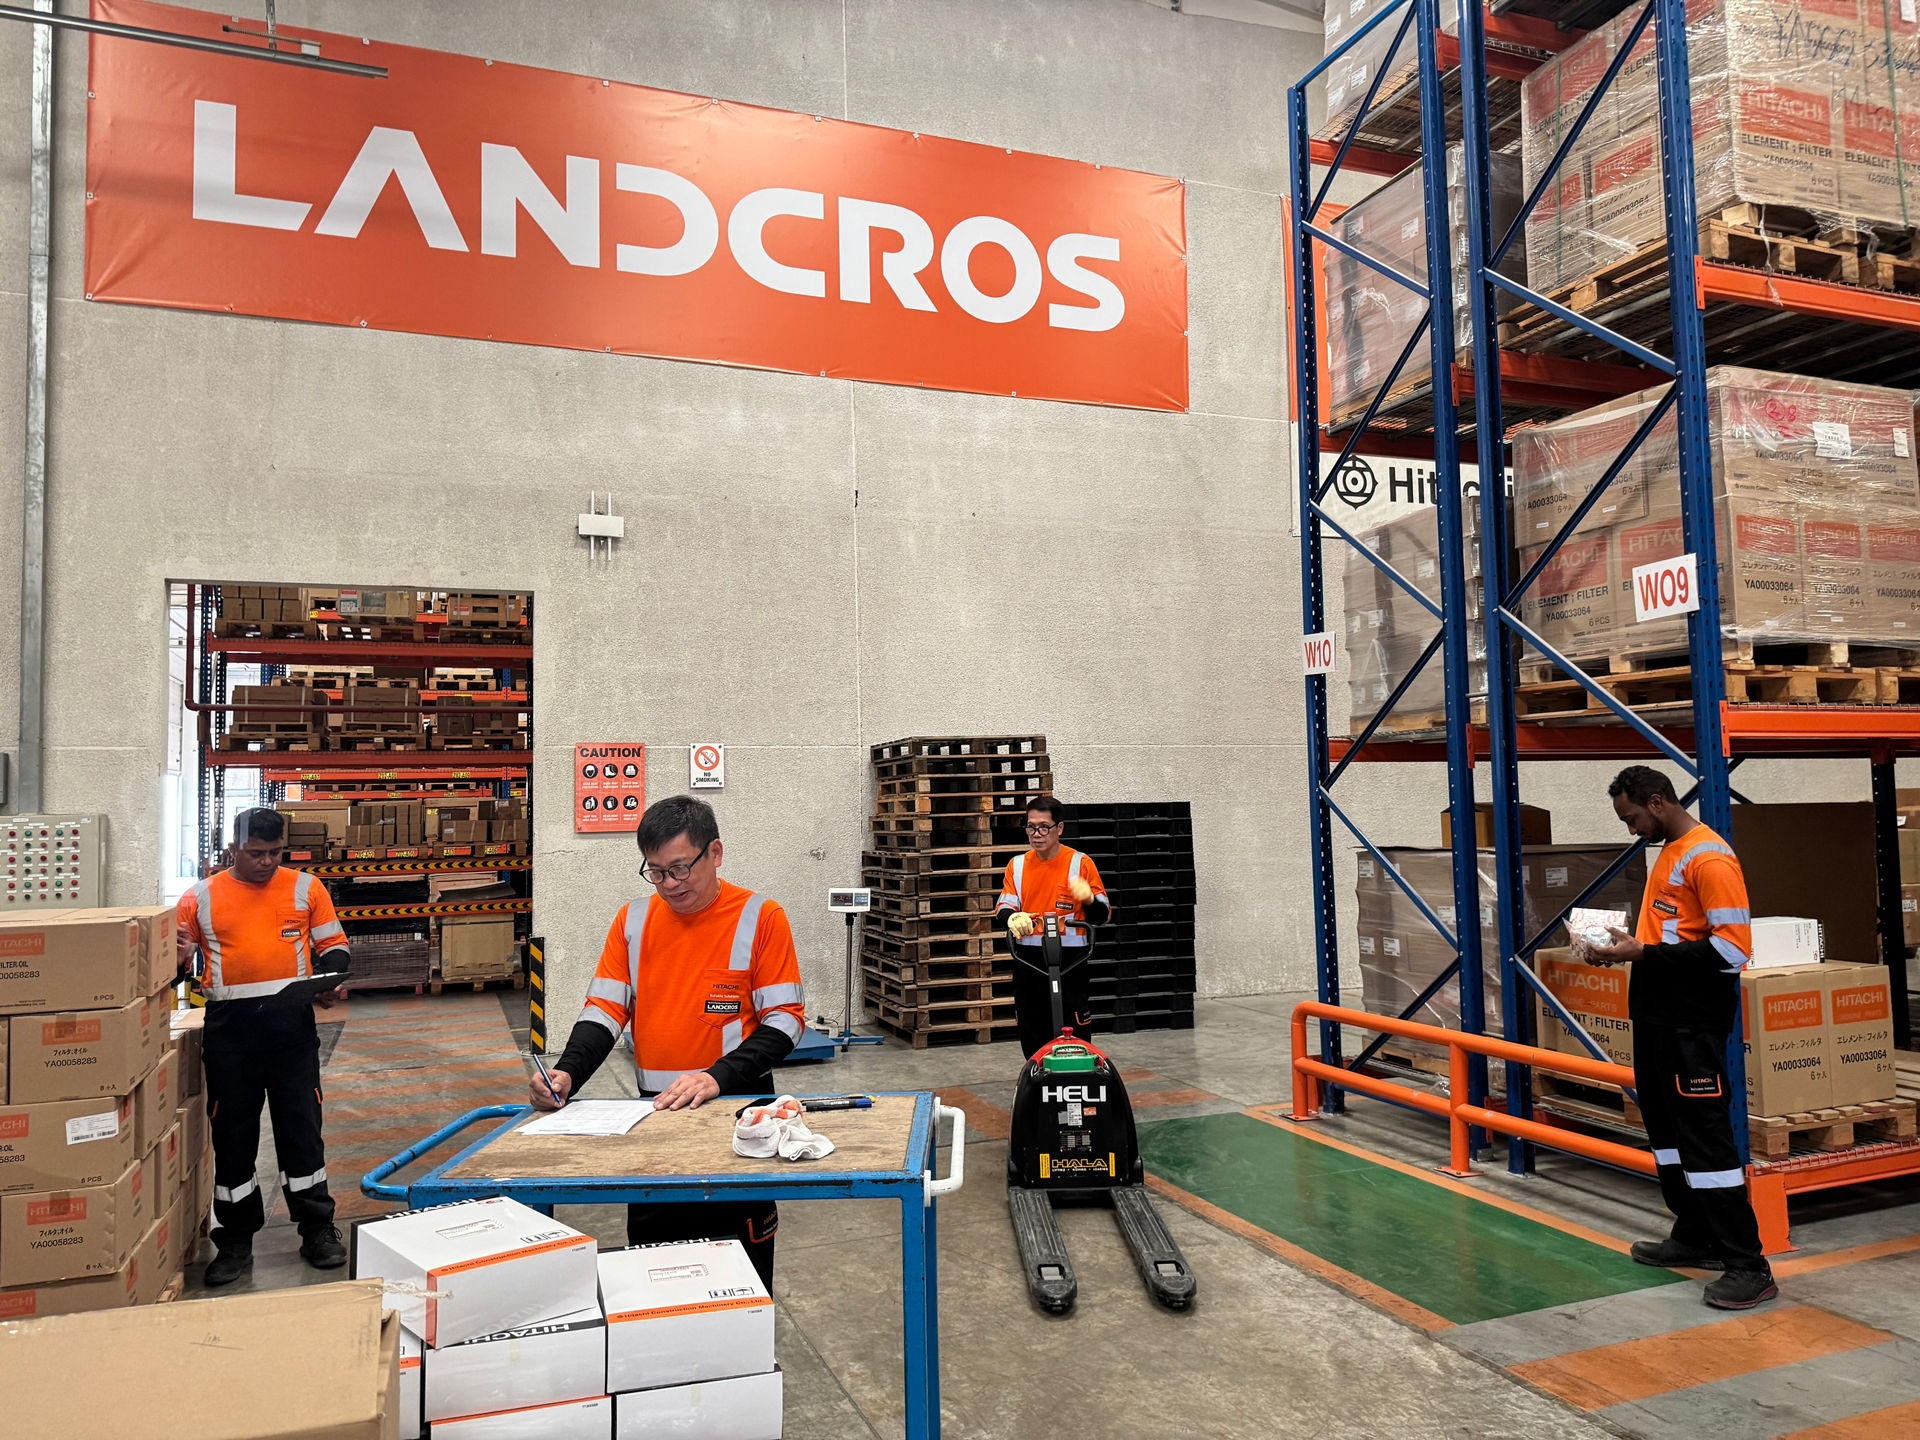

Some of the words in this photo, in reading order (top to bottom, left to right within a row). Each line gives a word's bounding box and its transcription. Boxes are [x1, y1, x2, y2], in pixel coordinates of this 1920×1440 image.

[1747, 92, 1823, 121] HITACHI
[1741, 133, 1790, 151] ELEMENT
[1798, 145, 1833, 159] FILTER
[192, 99, 1126, 334] LANDCROS
[1628, 527, 1684, 553] HITAC
[1576, 585, 1609, 600] FILTER
[1744, 578, 1794, 592] YA00033064
[1546, 606, 1591, 623] YA00033064
[1594, 615, 1610, 626] PCS
[580, 747, 642, 758] CAUTION
[18, 960, 29, 968] OIL
[0, 970, 40, 980] 00058283
[1546, 969, 1620, 994] HITACHI
[1767, 997, 1817, 1014] HITACHI
[1836, 991, 1883, 1008] HITACHI
[1595, 1016, 1630, 1032] FILTER
[44, 1057, 97, 1068] YA00058283
[1614, 1050, 1631, 1061] PCS
[1840, 1049, 1887, 1065] YA00033064
[1771, 1056, 1822, 1073] YA00033064
[1042, 1085, 1107, 1103] HELI
[1052, 1158, 1108, 1168] HALA
[386, 1197, 476, 1220] HITACHI
[30, 1236, 84, 1249] YA00058283
[624, 1237, 711, 1251] HITACHI
[651, 1305, 698, 1315] Construction
[698, 1301, 736, 1310] Machinery
